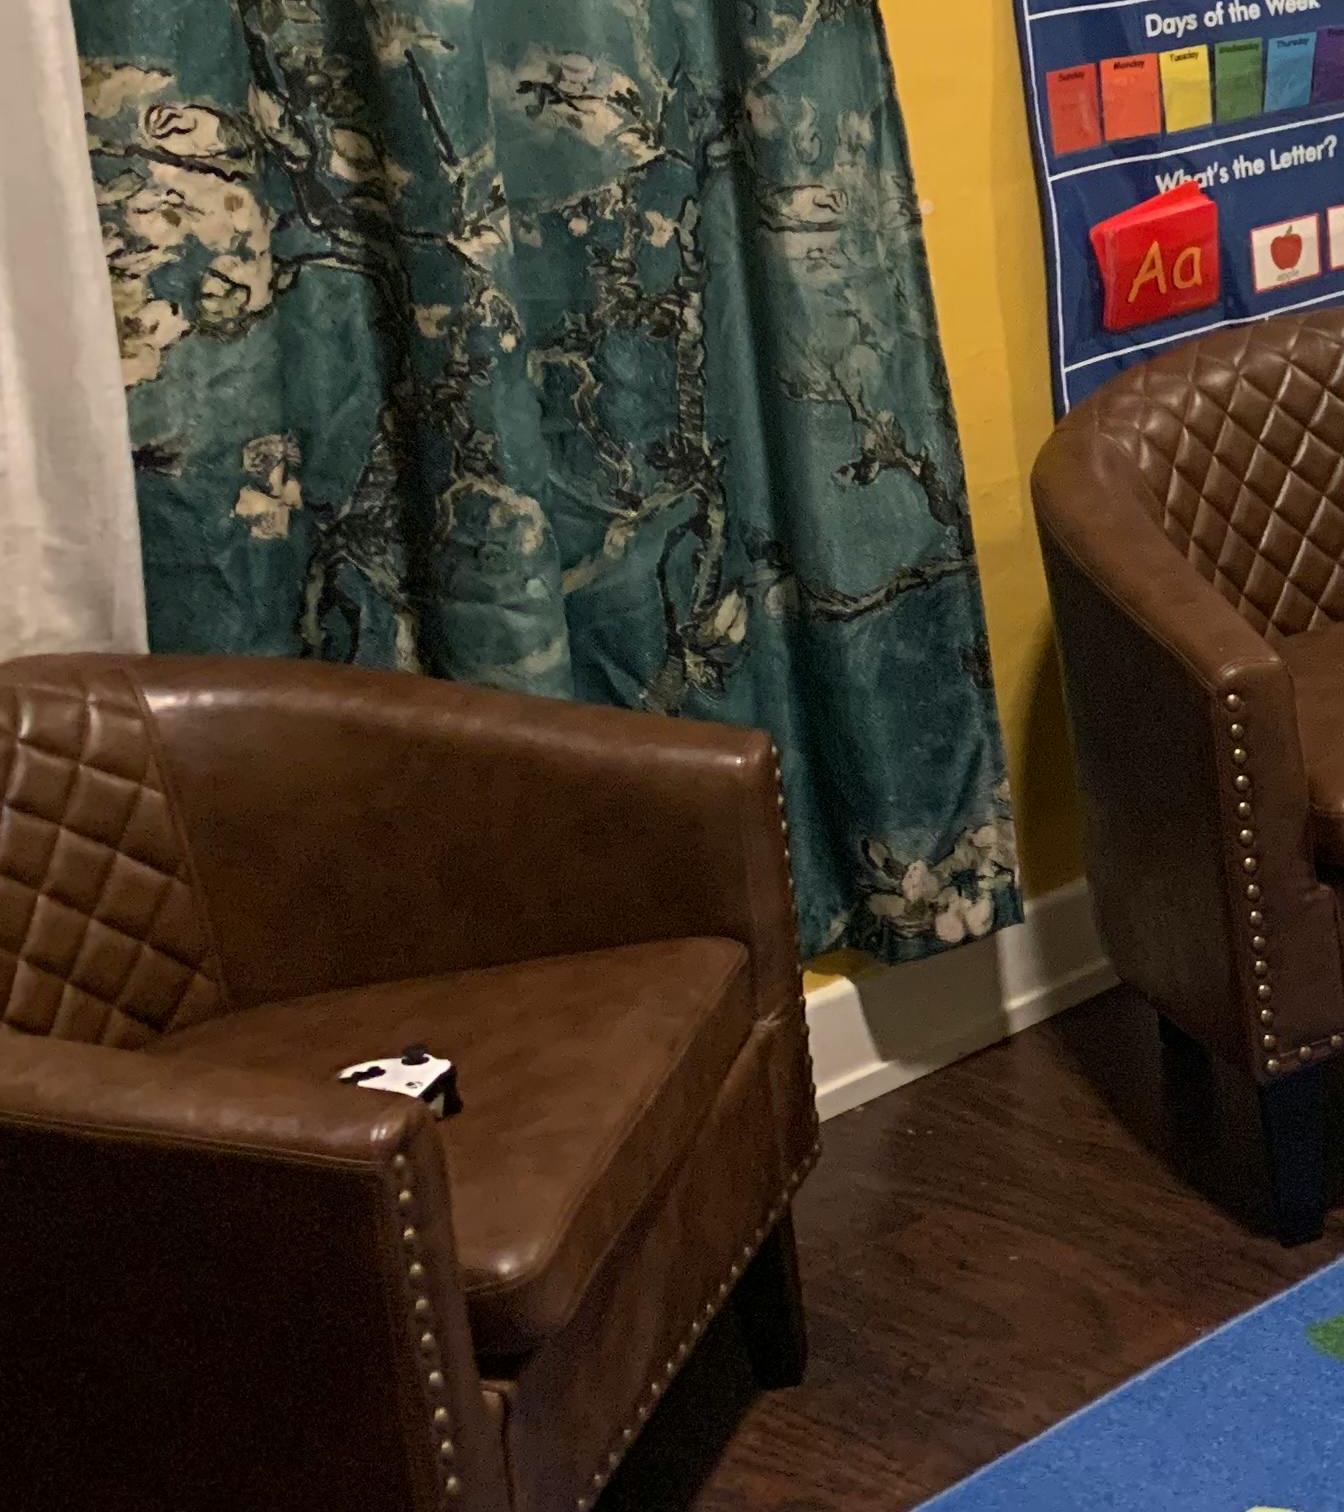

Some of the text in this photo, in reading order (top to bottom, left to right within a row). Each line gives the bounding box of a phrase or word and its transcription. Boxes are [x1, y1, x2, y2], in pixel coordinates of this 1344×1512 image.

[1145, 8, 1198, 38] Days
[1203, 1, 1225, 28] of
[1113, 59, 1145, 71] Monday
[1169, 49, 1200, 62] Tuesday
[1155, 134, 1338, 194] What's the Letter?
[1127, 240, 1202, 302] Aa
